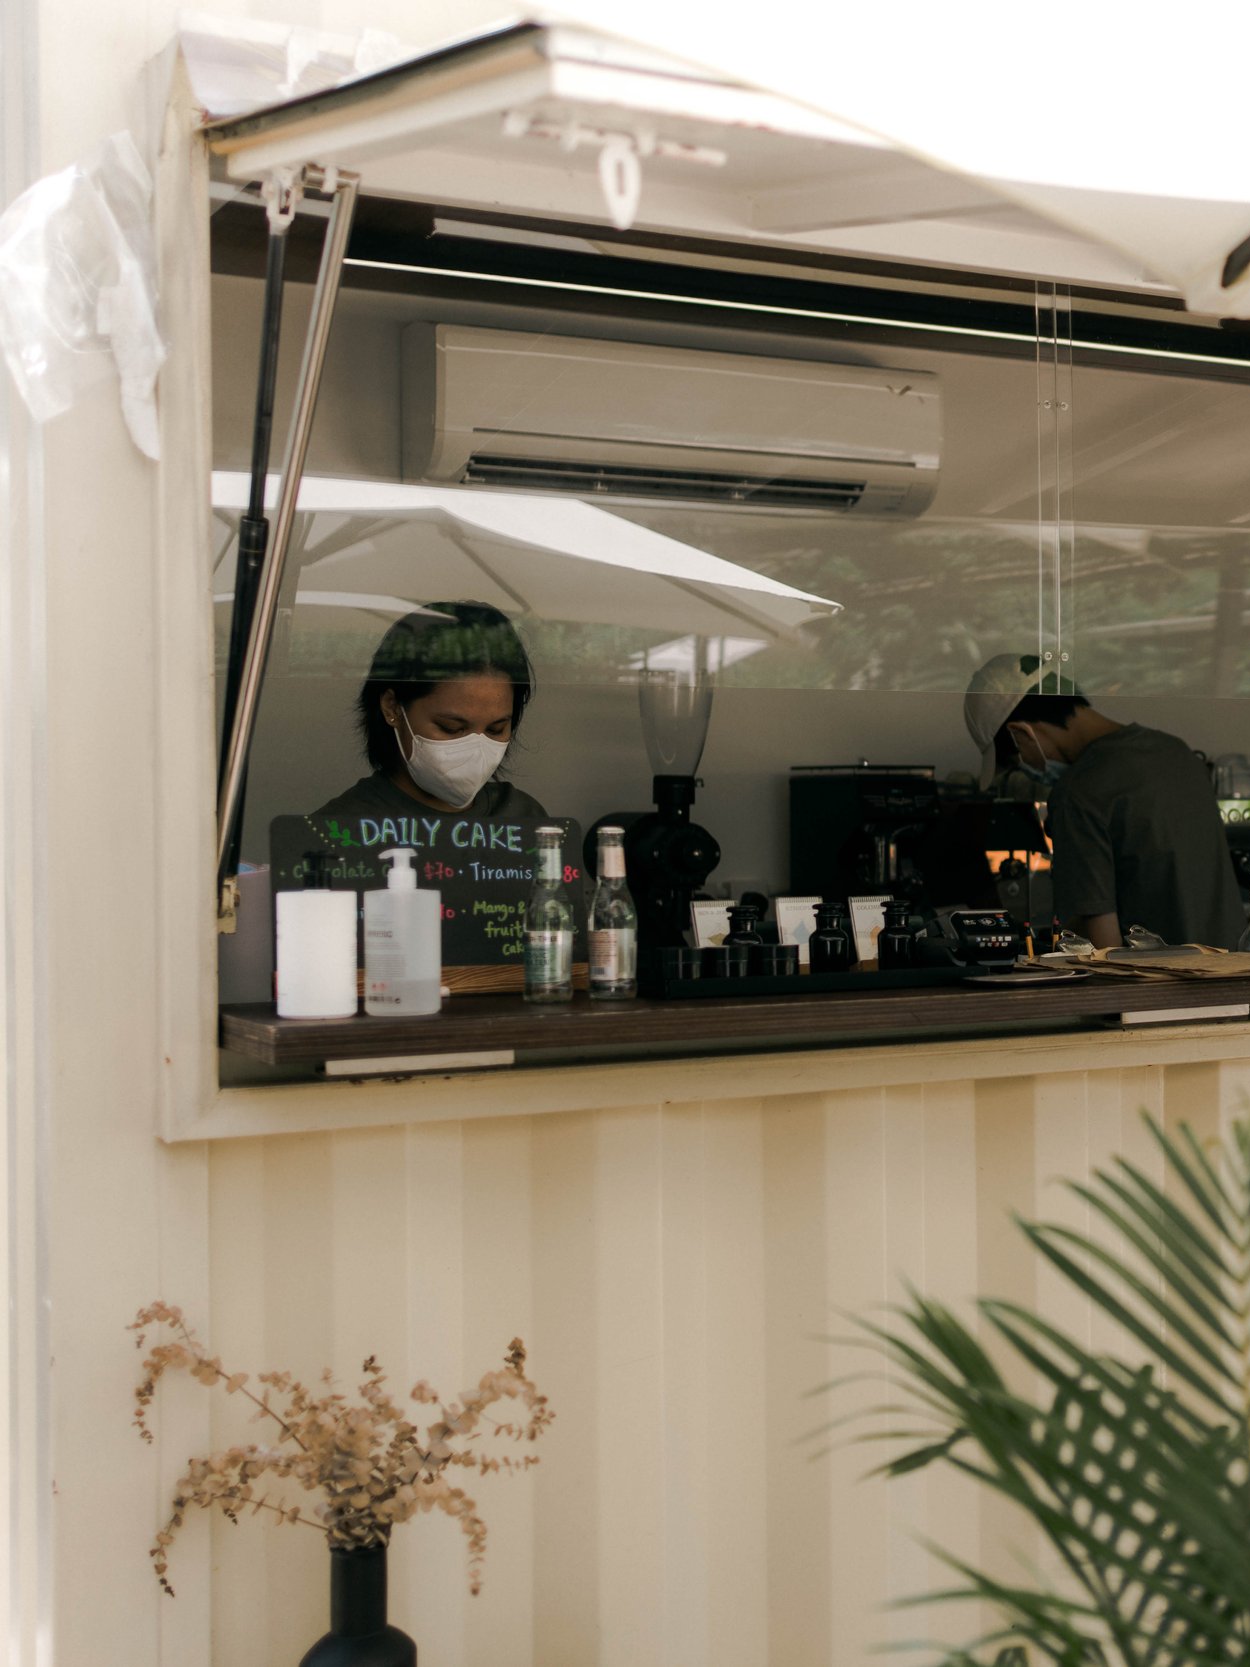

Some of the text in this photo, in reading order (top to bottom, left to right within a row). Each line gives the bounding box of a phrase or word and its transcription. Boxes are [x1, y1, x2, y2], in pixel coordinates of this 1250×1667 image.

[360, 817, 523, 853] DAILY CAKE
[469, 861, 533, 881] Tiramis
[472, 900, 515, 921] Mango
[483, 920, 523, 938] fruit
